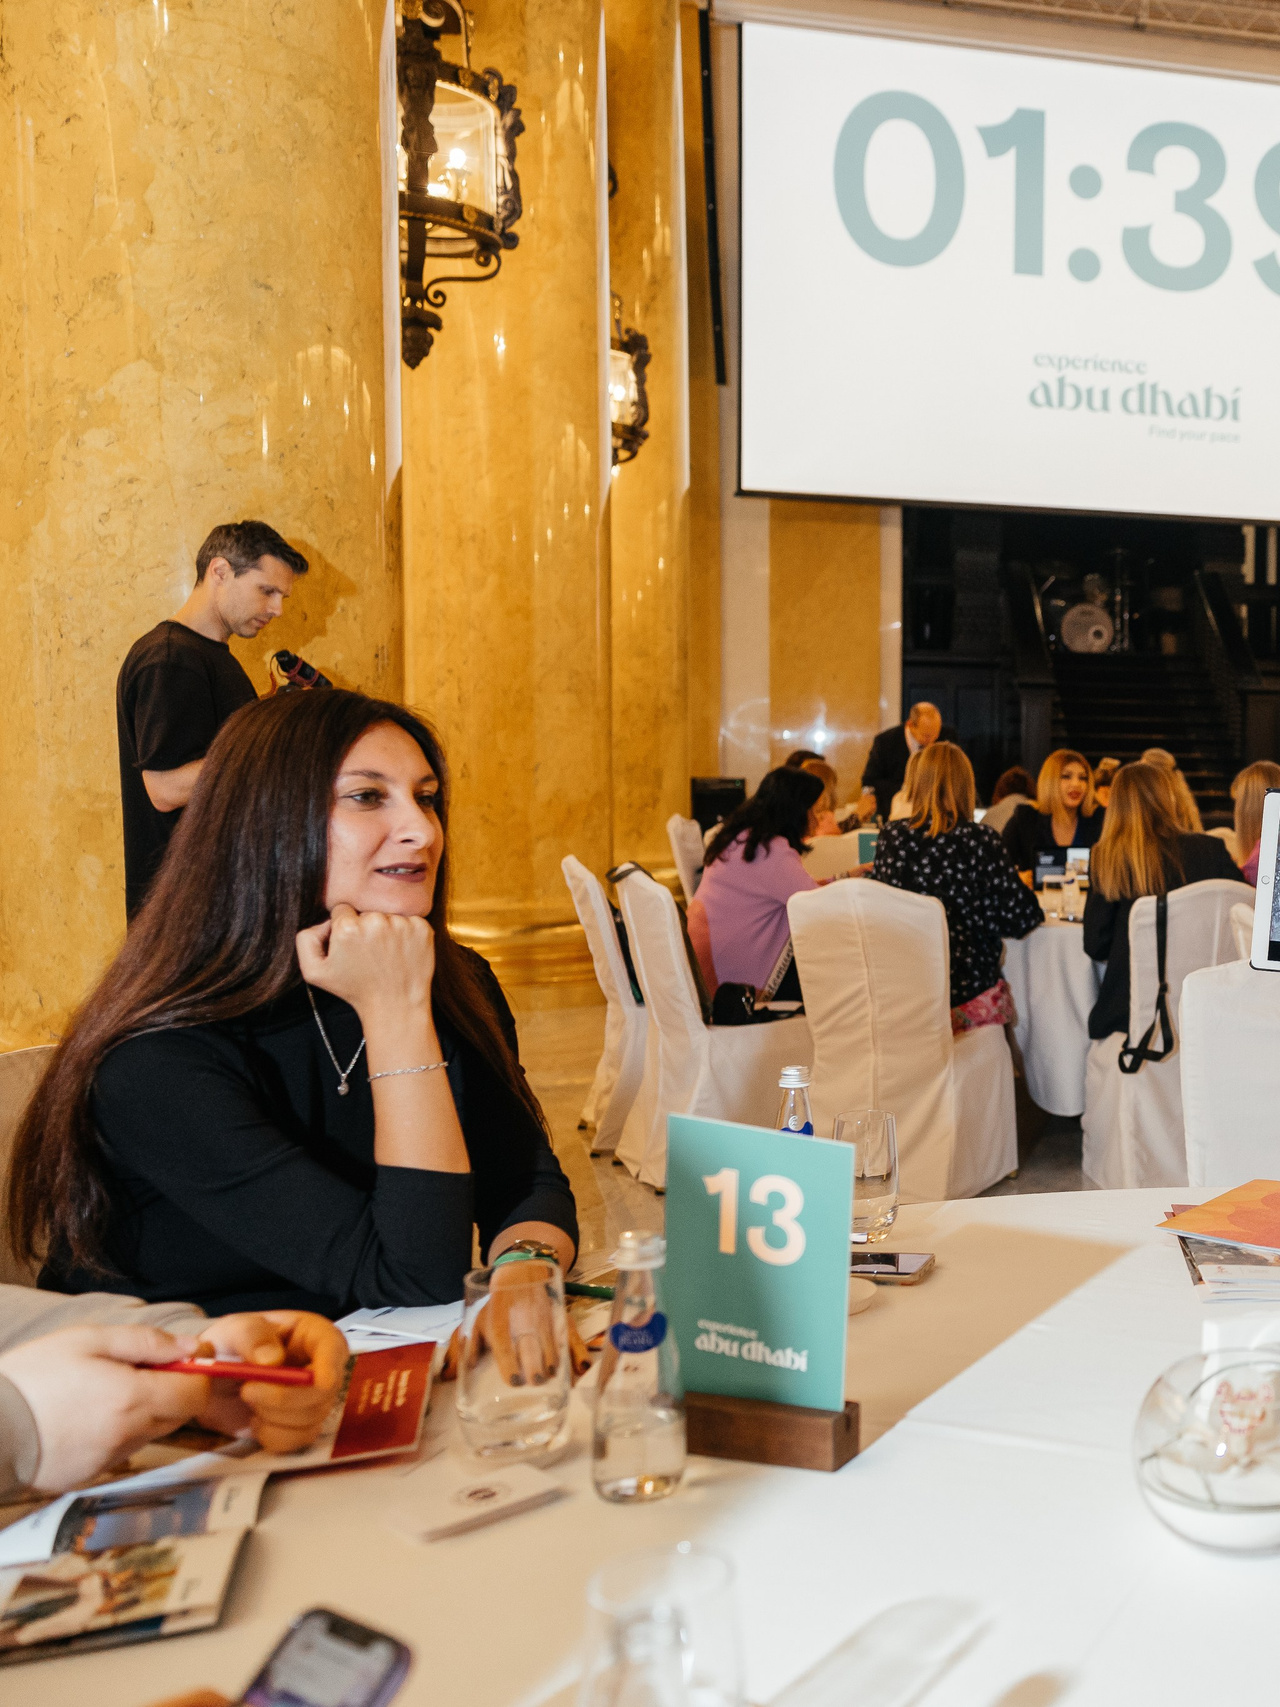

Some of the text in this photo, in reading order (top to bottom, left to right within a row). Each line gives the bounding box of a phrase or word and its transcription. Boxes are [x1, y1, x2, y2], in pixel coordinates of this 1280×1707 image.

[1029, 375, 1111, 413] abu
[702, 1167, 806, 1266] 13
[694, 1332, 740, 1358] abu
